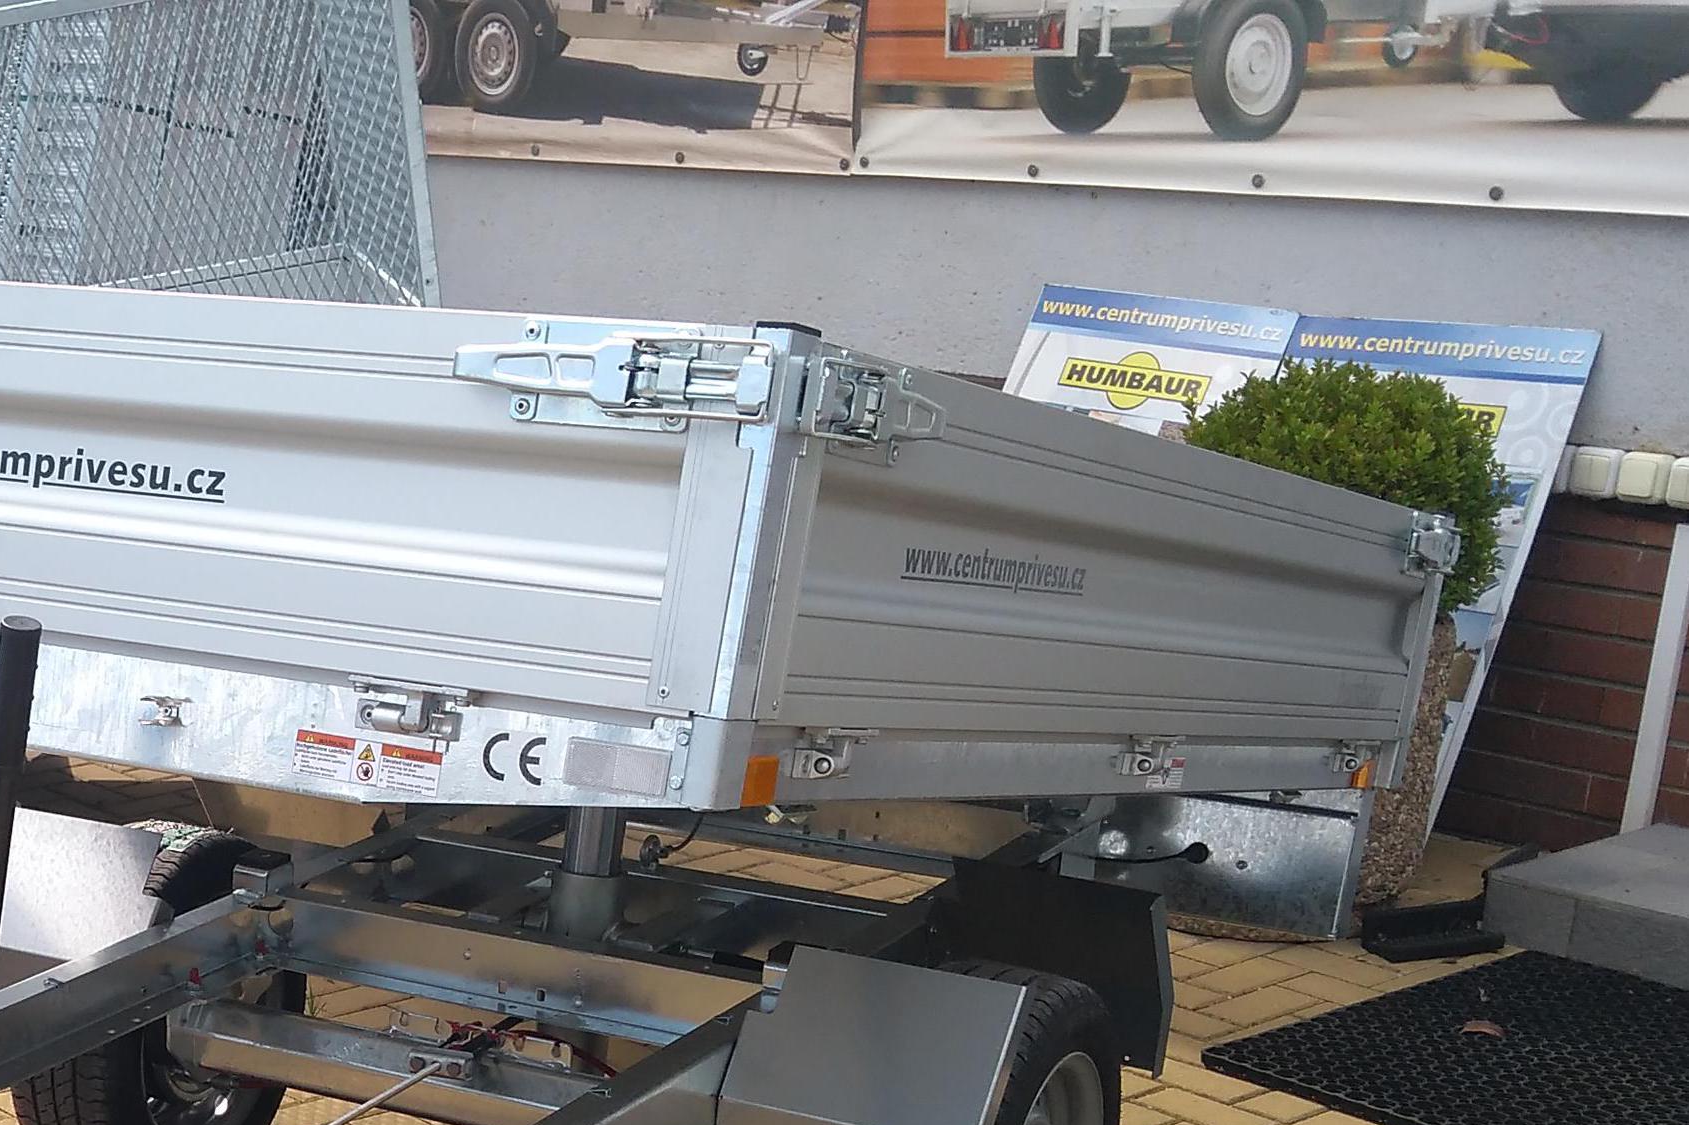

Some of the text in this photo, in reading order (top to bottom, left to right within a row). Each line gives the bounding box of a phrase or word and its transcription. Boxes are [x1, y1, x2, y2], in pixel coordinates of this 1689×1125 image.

[1042, 299, 1283, 342] www.centrumprivesu.cz
[1299, 331, 1586, 365] www.centrumprivesu.cz
[1066, 363, 1203, 397] HUMBAUR
[904, 547, 1087, 593] www.centrumprivesu.cz
[483, 733, 547, 786] CE
